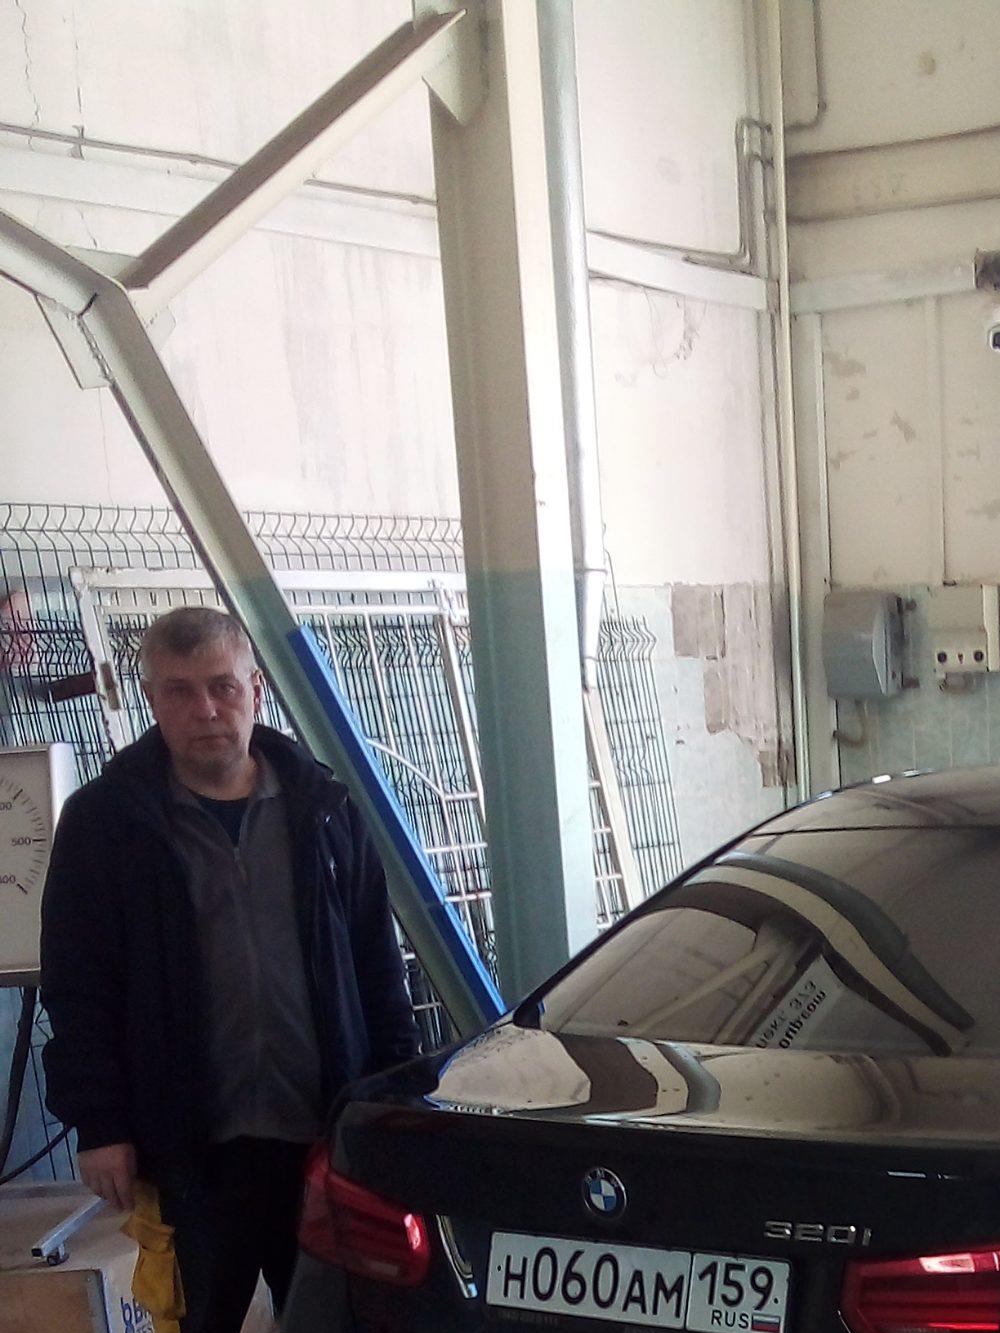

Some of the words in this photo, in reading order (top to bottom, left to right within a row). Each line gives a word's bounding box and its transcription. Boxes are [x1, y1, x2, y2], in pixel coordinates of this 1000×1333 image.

[11, 836, 32, 847] 500
[699, 1260, 774, 1311] 159
[710, 1309, 750, 1329] RUS
